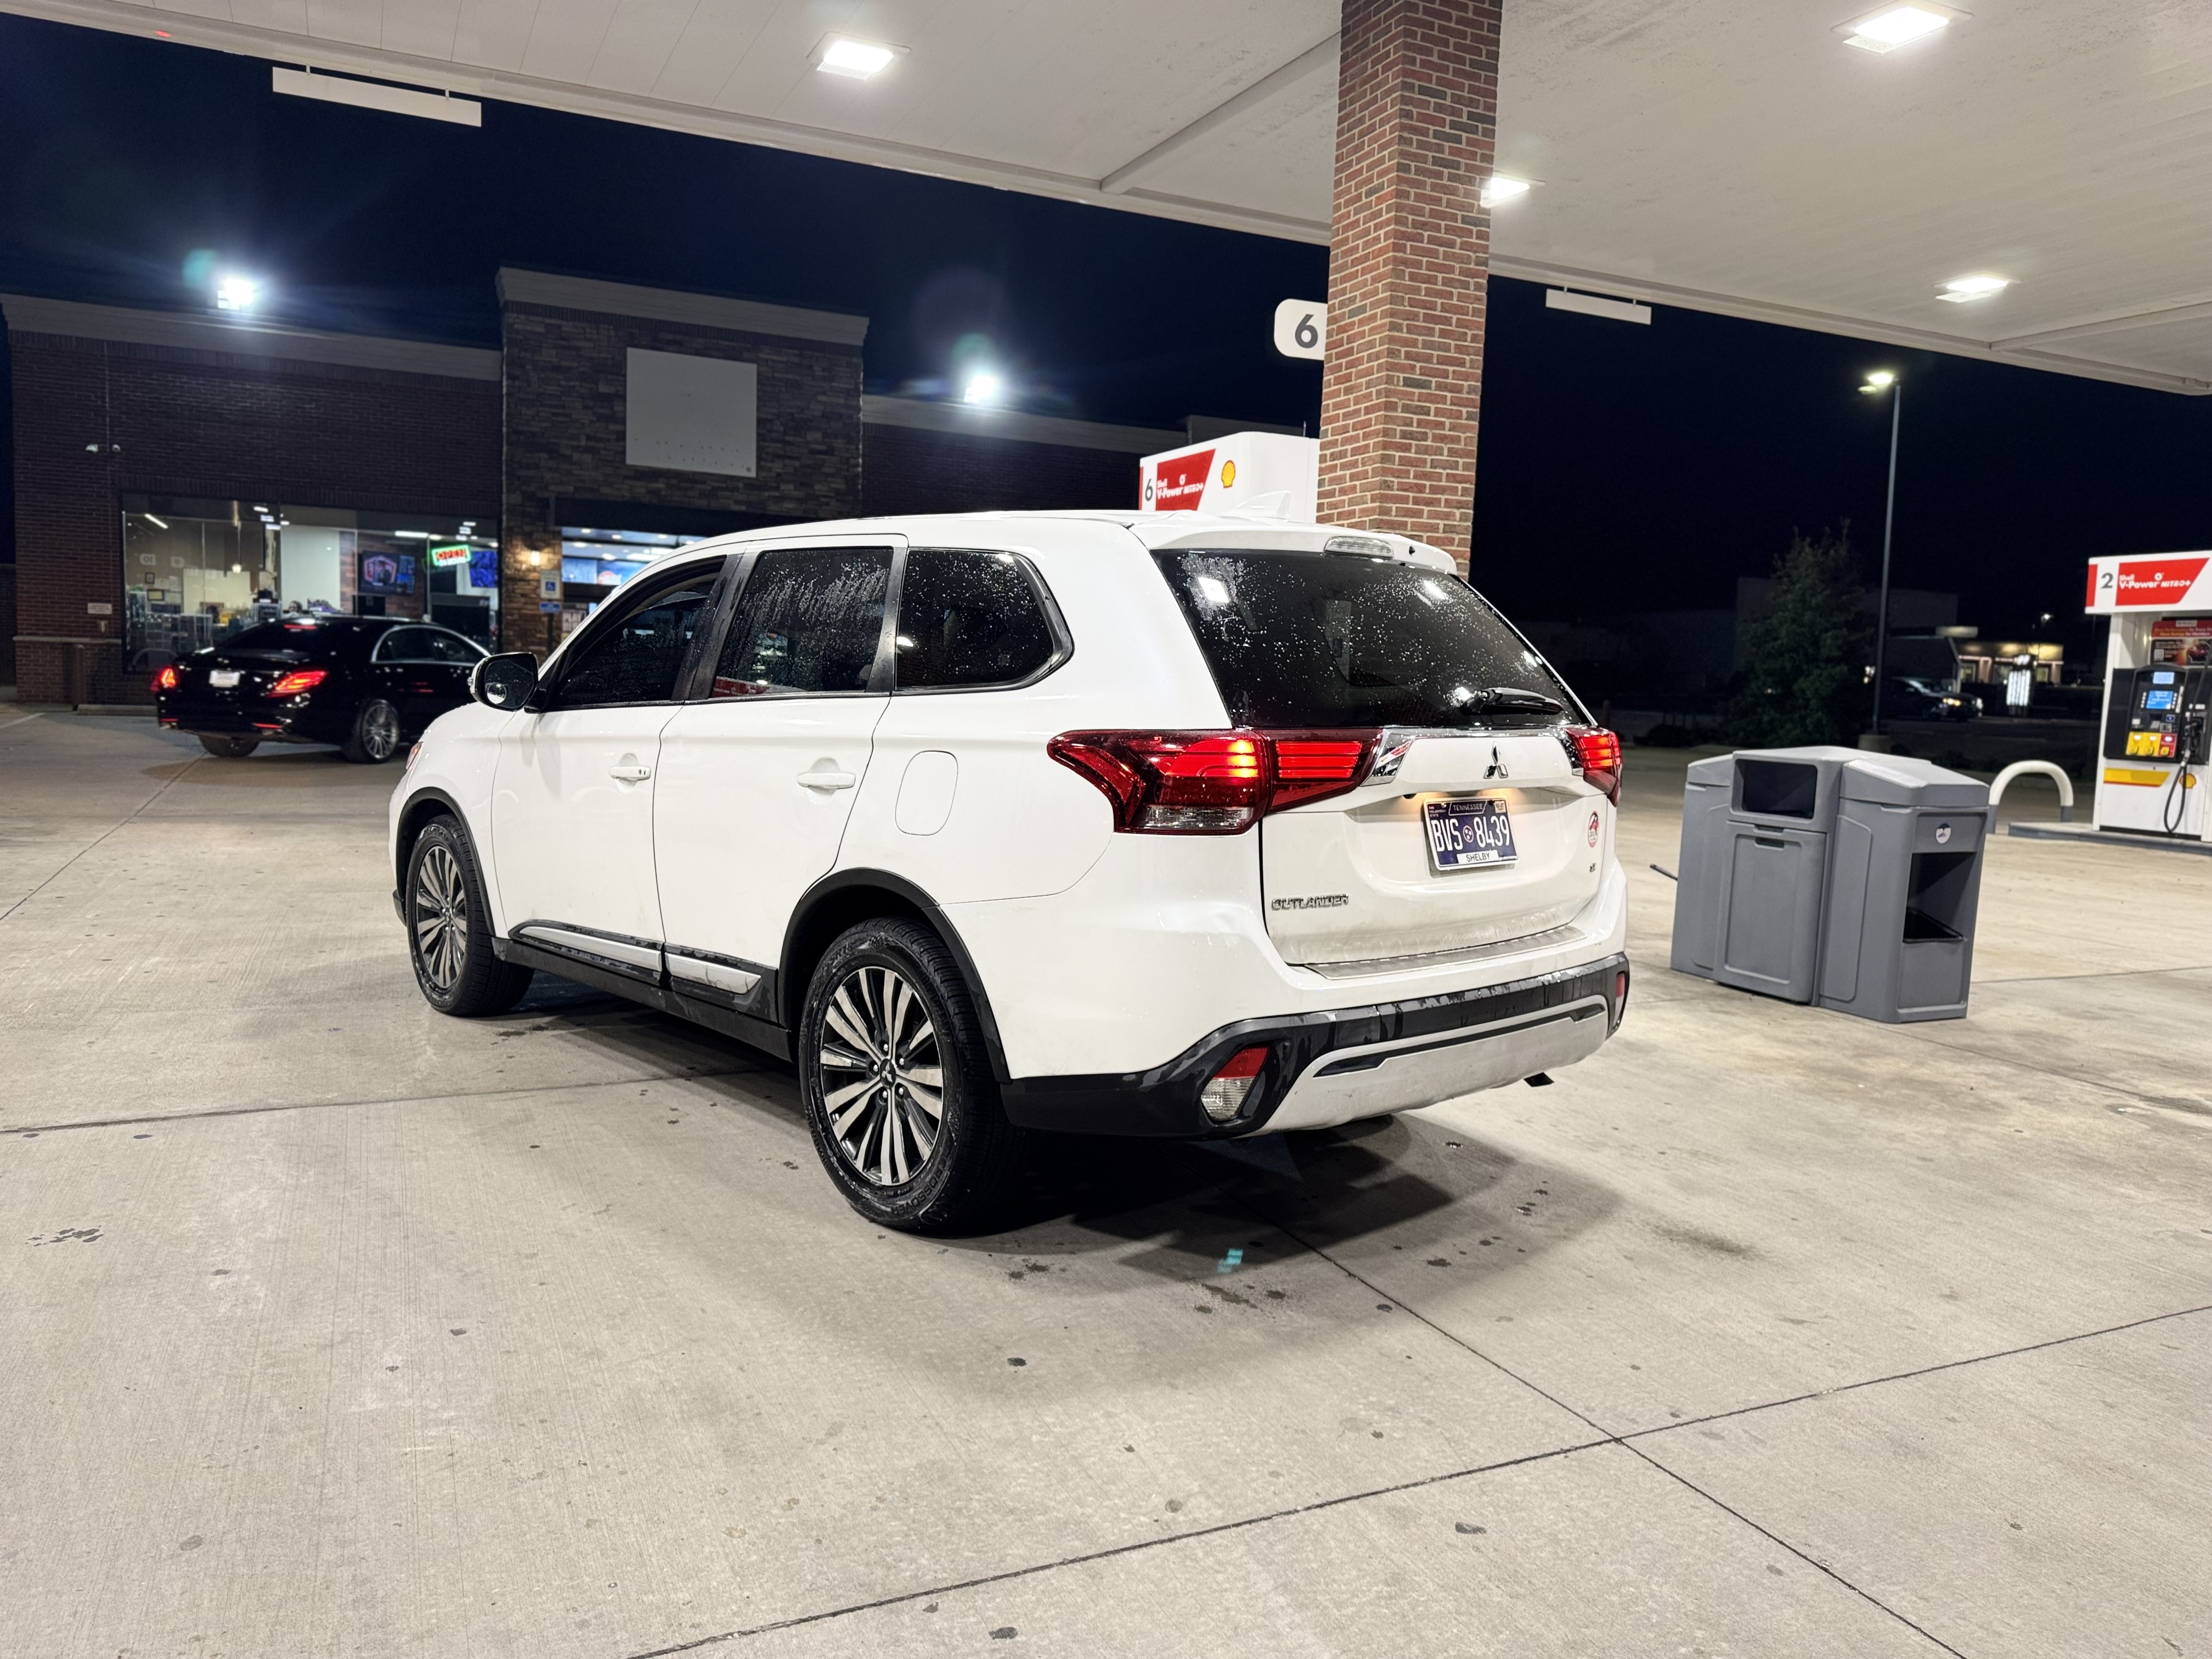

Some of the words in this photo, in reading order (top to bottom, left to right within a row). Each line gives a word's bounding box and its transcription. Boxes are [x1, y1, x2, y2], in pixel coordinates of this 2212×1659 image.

[1295, 313, 1318, 349] 6
[1145, 478, 1153, 501] 6
[436, 549, 466, 560] OPEN
[2101, 573, 2113, 589] 2
[2119, 580, 2159, 589] V-Power
[1453, 803, 1483, 811] TENNESSEE
[1431, 819, 1463, 852] BVS
[1473, 815, 1510, 848] 8439
[1466, 853, 1491, 862] SHELBY
[1272, 894, 1349, 911] OUTLANDER
